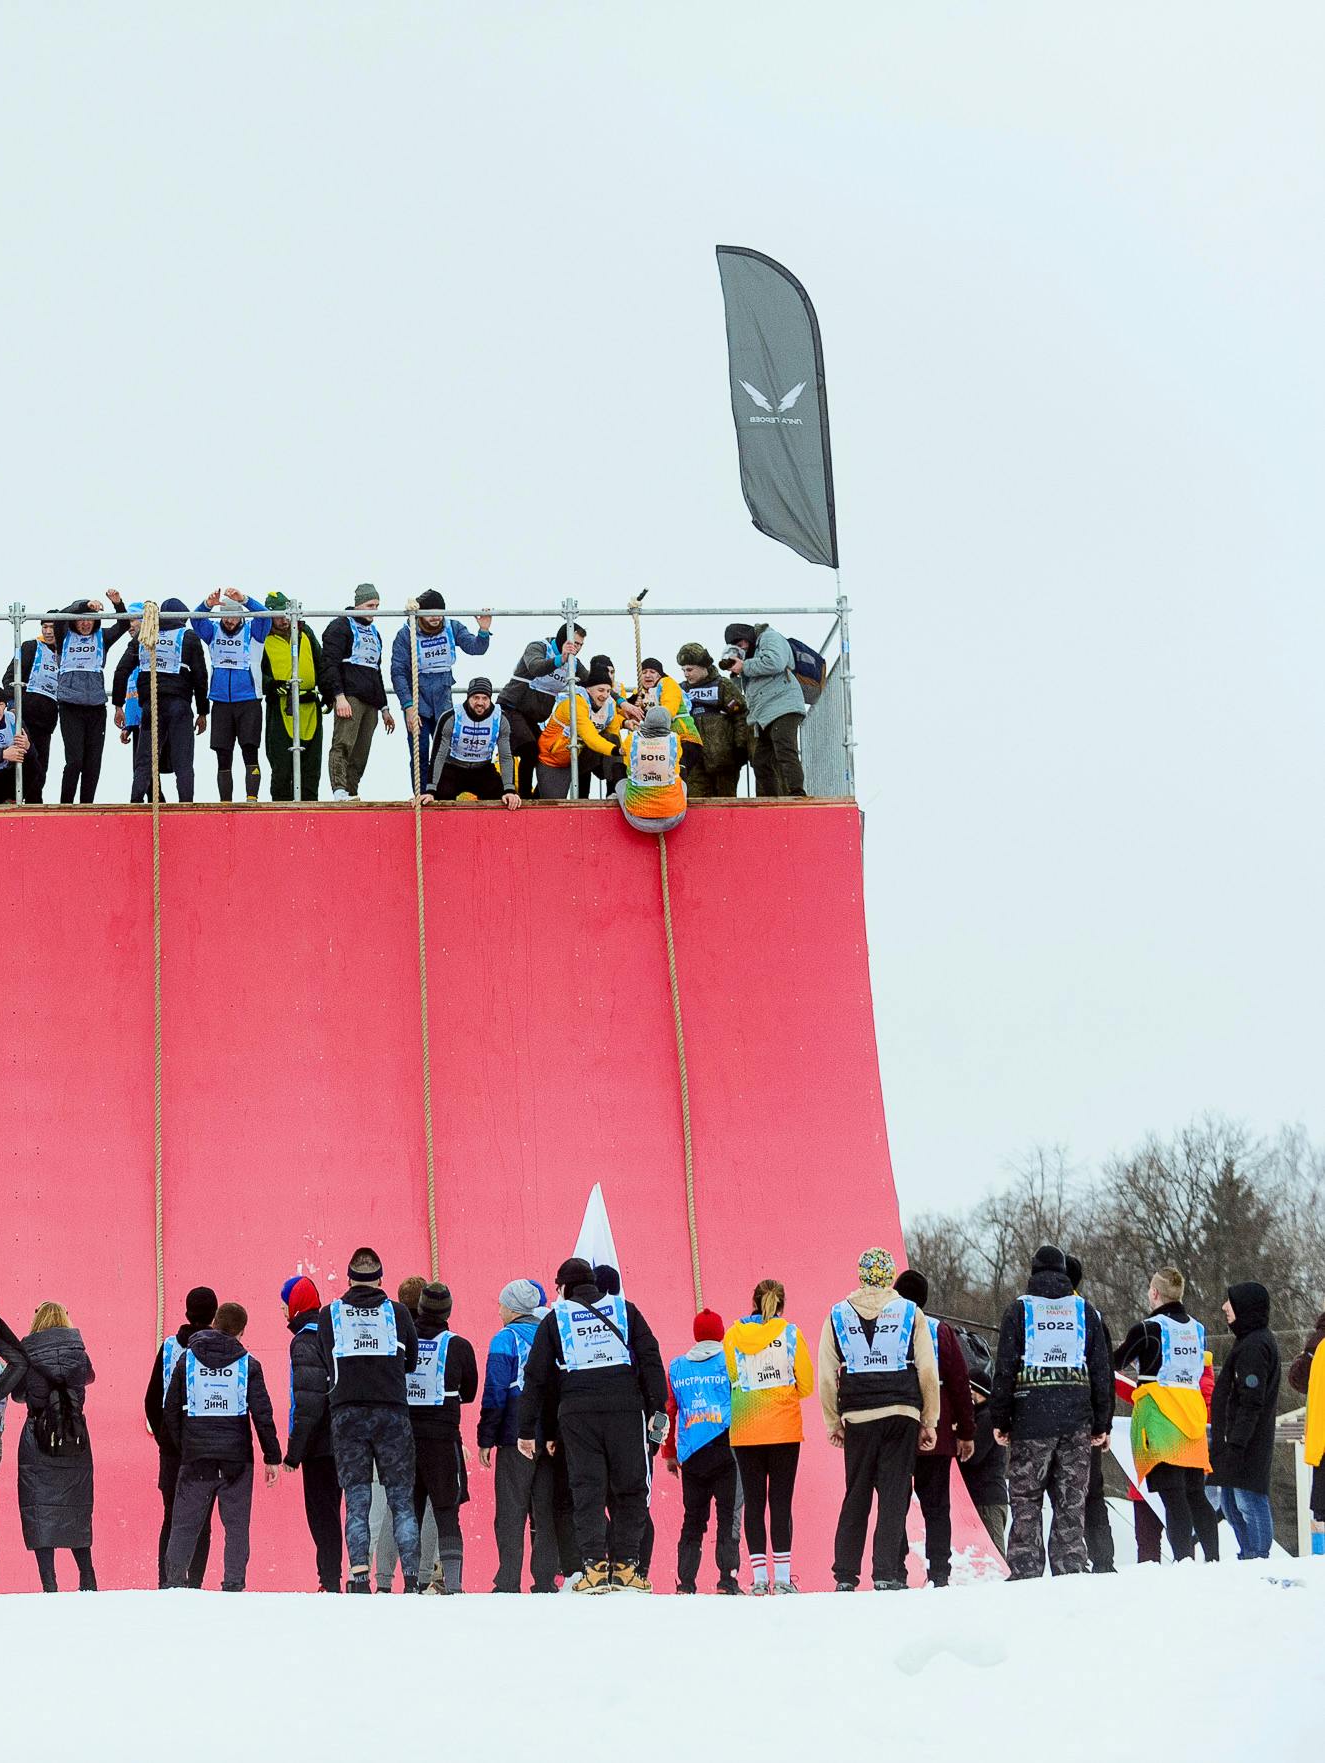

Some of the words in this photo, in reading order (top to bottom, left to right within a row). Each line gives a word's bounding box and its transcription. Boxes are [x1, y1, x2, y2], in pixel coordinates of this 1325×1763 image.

[425, 648, 447, 658] 5142
[346, 1309, 379, 1317] 5135
[575, 1308, 611, 1319] почтех
[1037, 1322, 1074, 1330] 5022
[354, 1338, 379, 1350] ЗИМА
[1174, 1347, 1197, 1355] 5014
[864, 1355, 888, 1366] ЗИМА
[1043, 1352, 1067, 1363] ЗИМА
[199, 1368, 233, 1377] 5310
[757, 1370, 781, 1382] ЗИМА
[673, 1375, 727, 1389] ИНСТРУКТОР
[408, 1388, 426, 1399] ИМА
[204, 1399, 228, 1410] ЗИМА
